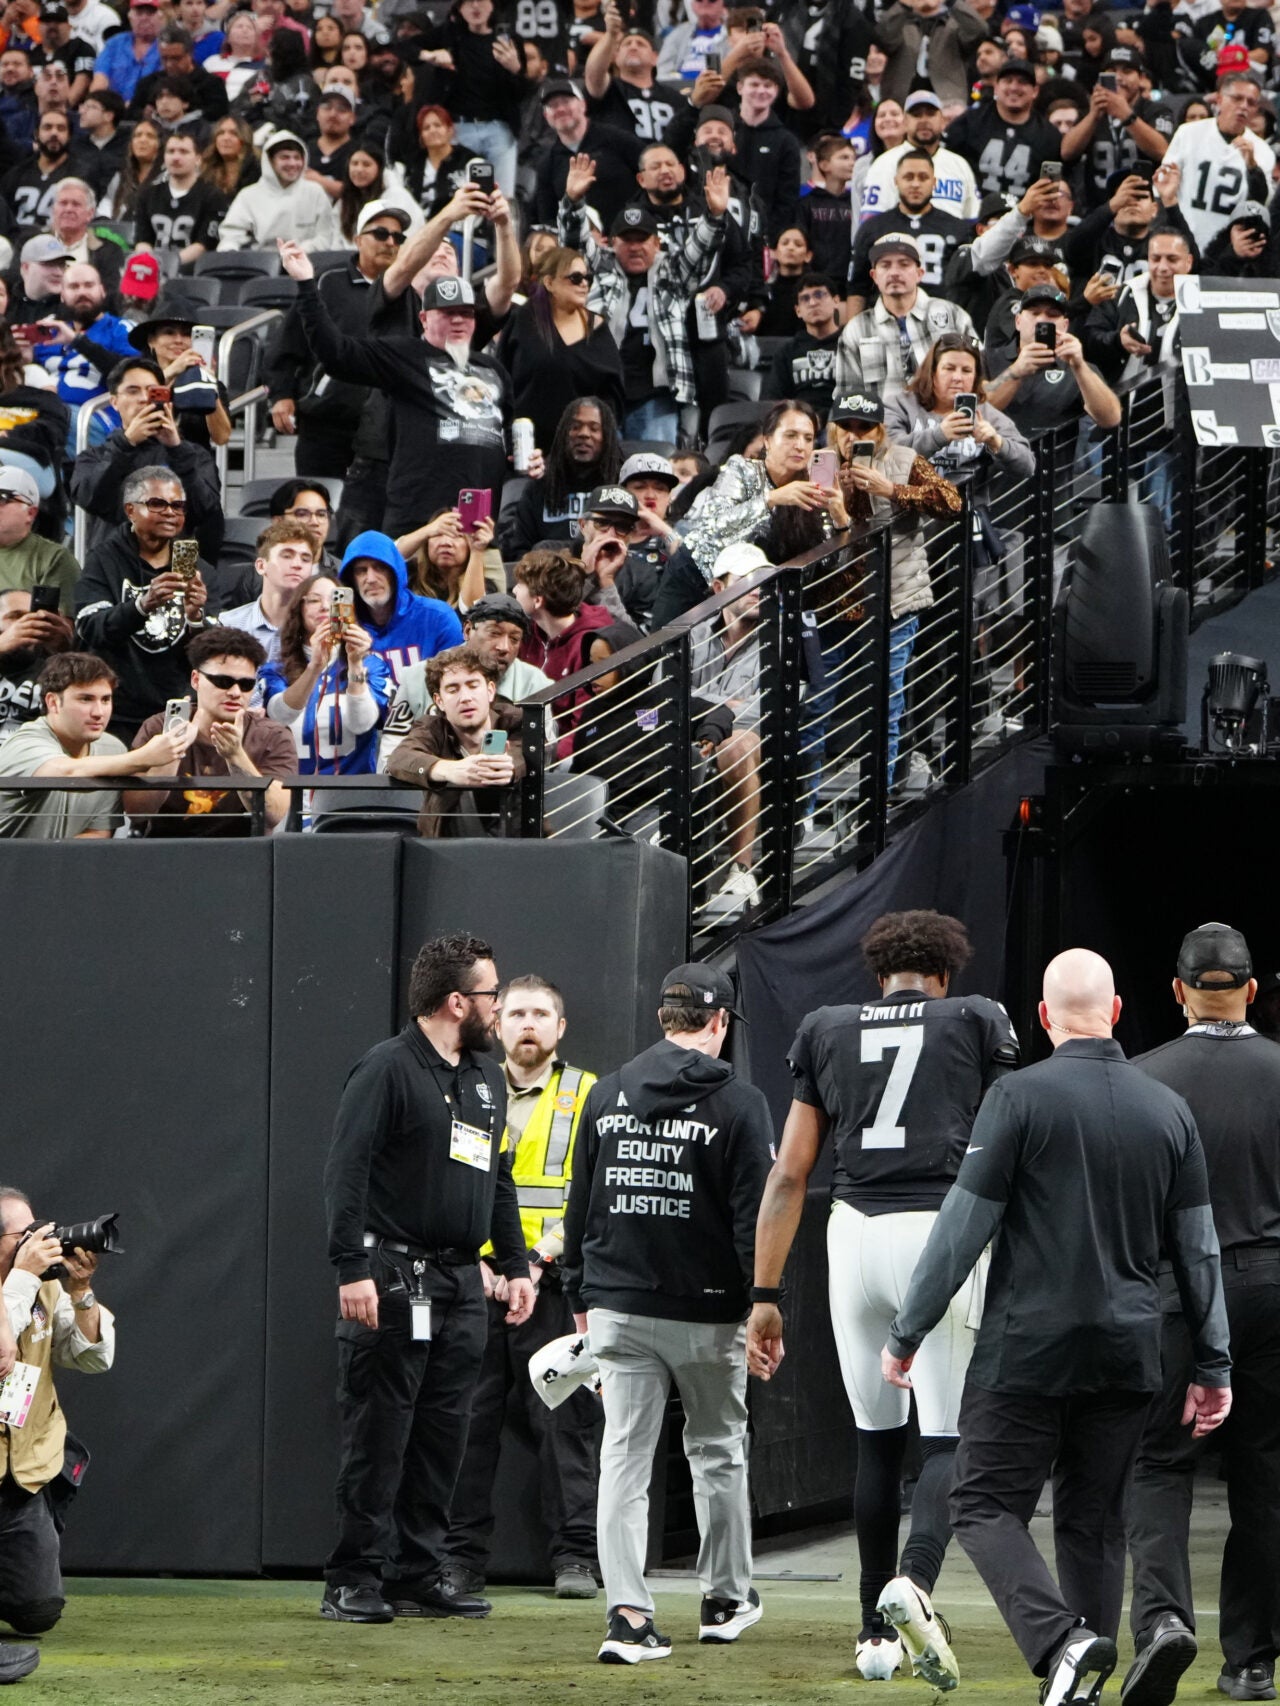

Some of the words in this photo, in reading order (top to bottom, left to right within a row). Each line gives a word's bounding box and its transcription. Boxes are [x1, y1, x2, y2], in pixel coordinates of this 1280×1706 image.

[978, 138, 1031, 196] 44
[1191, 161, 1243, 215] 12
[860, 1001, 927, 1021] SMITH
[860, 1024, 924, 1149] 7
[596, 1114, 719, 1146] OPPORTUNITY
[617, 1140, 684, 1165] EQUITY
[605, 1166, 694, 1192] FREEDOM
[609, 1194, 691, 1219] JUSTICE
